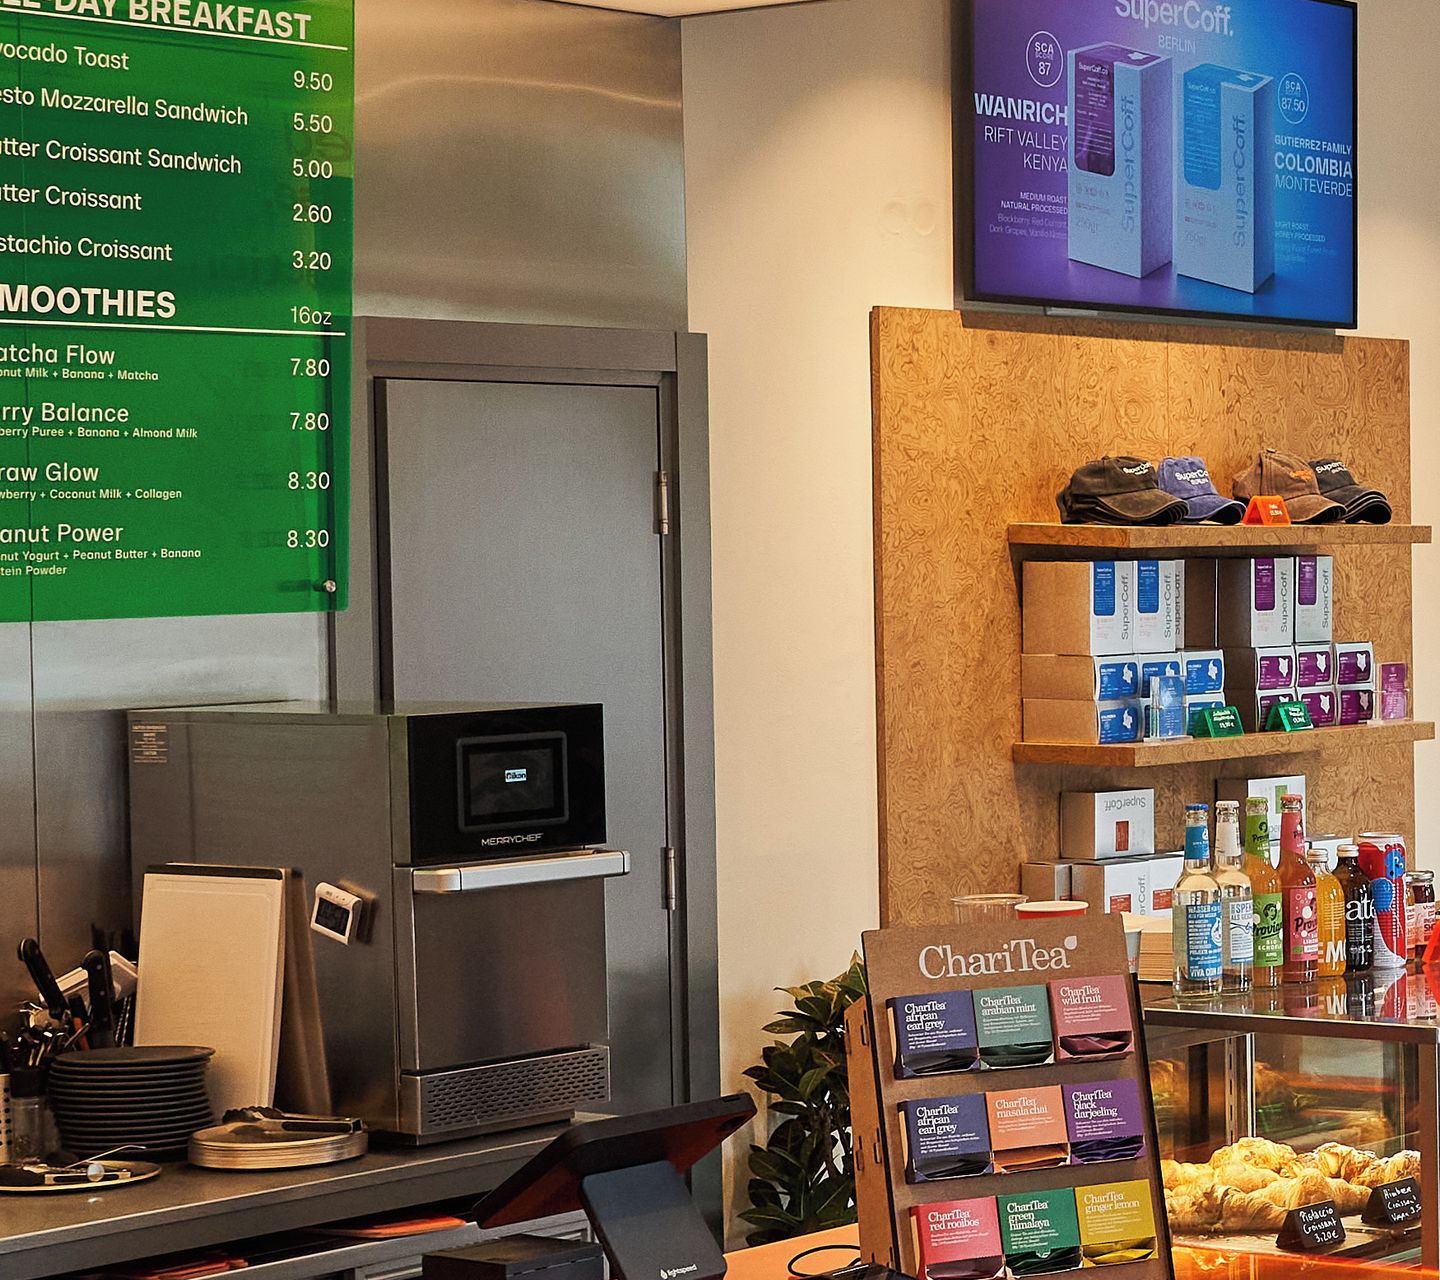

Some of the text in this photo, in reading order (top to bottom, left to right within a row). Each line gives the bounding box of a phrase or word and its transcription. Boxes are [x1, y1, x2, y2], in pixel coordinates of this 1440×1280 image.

[1034, 41, 1054, 55] SCA
[1158, 34, 1196, 54] BERLIN
[73, 46, 130, 70] Toast
[1038, 62, 1051, 76] 87
[293, 70, 333, 92] 9.50
[0, 86, 249, 126] sto Mozzarella Sandwich
[1281, 96, 1306, 113] 87.50
[293, 113, 333, 134] 5.50
[984, 125, 1068, 151] RIFT VALLEY
[1274, 134, 1352, 156] GUTIERREZ FAMILY
[0, 137, 242, 175] tter Croissant Sandwich
[1023, 153, 1068, 172] KENYA
[292, 158, 333, 180] 5.00
[1274, 151, 1353, 179] COLOMBIA
[1274, 174, 1353, 198] MONTEVERDE
[0, 183, 143, 211] tter Croissant
[1020, 191, 1046, 203] MEDIUM
[1046, 194, 1067, 204] ROAST
[292, 203, 332, 224] 2.60
[1001, 200, 1068, 215] NATURAL PROCESSED
[77, 237, 173, 261] Croissant
[292, 250, 332, 271] 3.20
[0, 284, 176, 318] MOOTHIES
[290, 305, 332, 326] 16oz
[66, 344, 116, 365] Flow
[25, 368, 48, 378] Milk
[62, 368, 105, 379] Banana
[117, 370, 159, 381] Matcha
[290, 358, 331, 377] 7.80
[2, 402, 129, 426] rry Balance
[289, 412, 330, 431] 7.80
[32, 426, 64, 437] Puree
[78, 426, 120, 438] Banana
[132, 427, 173, 438] Almond
[176, 427, 198, 438] Milk
[45, 462, 99, 482] Glow
[287, 472, 331, 490] 8.30
[50, 489, 96, 499] Coconut
[100, 488, 122, 499] Milk
[135, 488, 182, 500] Collagen
[57, 523, 124, 542] Power
[287, 530, 330, 548] 8.30
[23, 551, 60, 563] Yogurt
[73, 550, 112, 560] Peanut
[115, 549, 148, 559] Butter
[161, 549, 201, 559] Banana
[26, 565, 67, 576] Powder
[481, 833, 544, 846] MERRYCHEF
[918, 938, 1071, 980] ChariTea
[1060, 985, 1100, 998] ChariTea
[980, 994, 1022, 1008] ChariTea
[1061, 994, 1102, 1006] wild fruit
[904, 1001, 946, 1014] ChariTea
[981, 1003, 1036, 1017] arabian mint
[905, 1011, 938, 1024] african
[906, 1019, 945, 1031] earl grey
[1071, 1089, 1112, 1101] ChariTea
[995, 1097, 1036, 1110] ChariTea
[1073, 1099, 1097, 1110] black
[916, 1104, 958, 1118] ChariTea
[996, 1104, 1047, 1118] masala chai
[1074, 1107, 1118, 1120] darjeeling
[917, 1114, 950, 1127] african
[918, 1123, 957, 1135] earl grey
[1084, 1191, 1124, 1204] ChariTea
[1006, 1200, 1048, 1213] ChariTea
[1085, 1200, 1140, 1215] ginger lemon
[928, 1209, 970, 1222] ChariTea
[1008, 1211, 1035, 1223] green
[930, 1218, 980, 1231] red rooibos
[1009, 1219, 1050, 1231] himalaya
[667, 1264, 698, 1278] lightspeed
